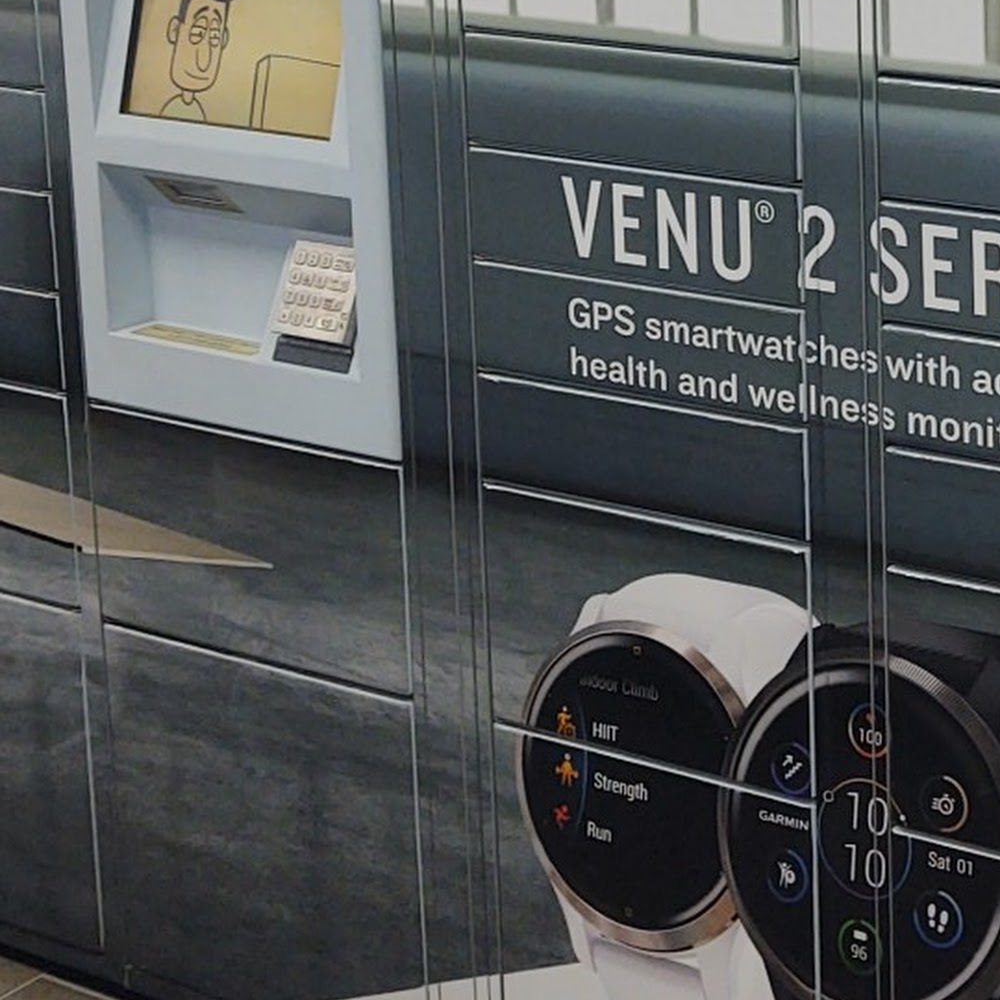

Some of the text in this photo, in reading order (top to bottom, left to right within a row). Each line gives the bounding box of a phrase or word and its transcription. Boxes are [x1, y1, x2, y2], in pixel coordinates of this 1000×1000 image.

[796, 204, 837, 294] 2
[567, 297, 637, 337] GPS
[644, 315, 880, 375] smartwatches
[885, 352, 961, 391] with
[569, 346, 668, 391] health
[678, 372, 738, 404] and
[747, 381, 896, 432] wellness
[592, 721, 619, 742] HIIT
[858, 726, 883, 747] 100
[593, 772, 649, 801] Strength
[758, 809, 810, 832] GARMIN
[846, 791, 890, 837] 10
[586, 820, 612, 843] Run
[844, 843, 887, 889] 10
[927, 850, 974, 876] Sat 01
[850, 943, 869, 962] 96
